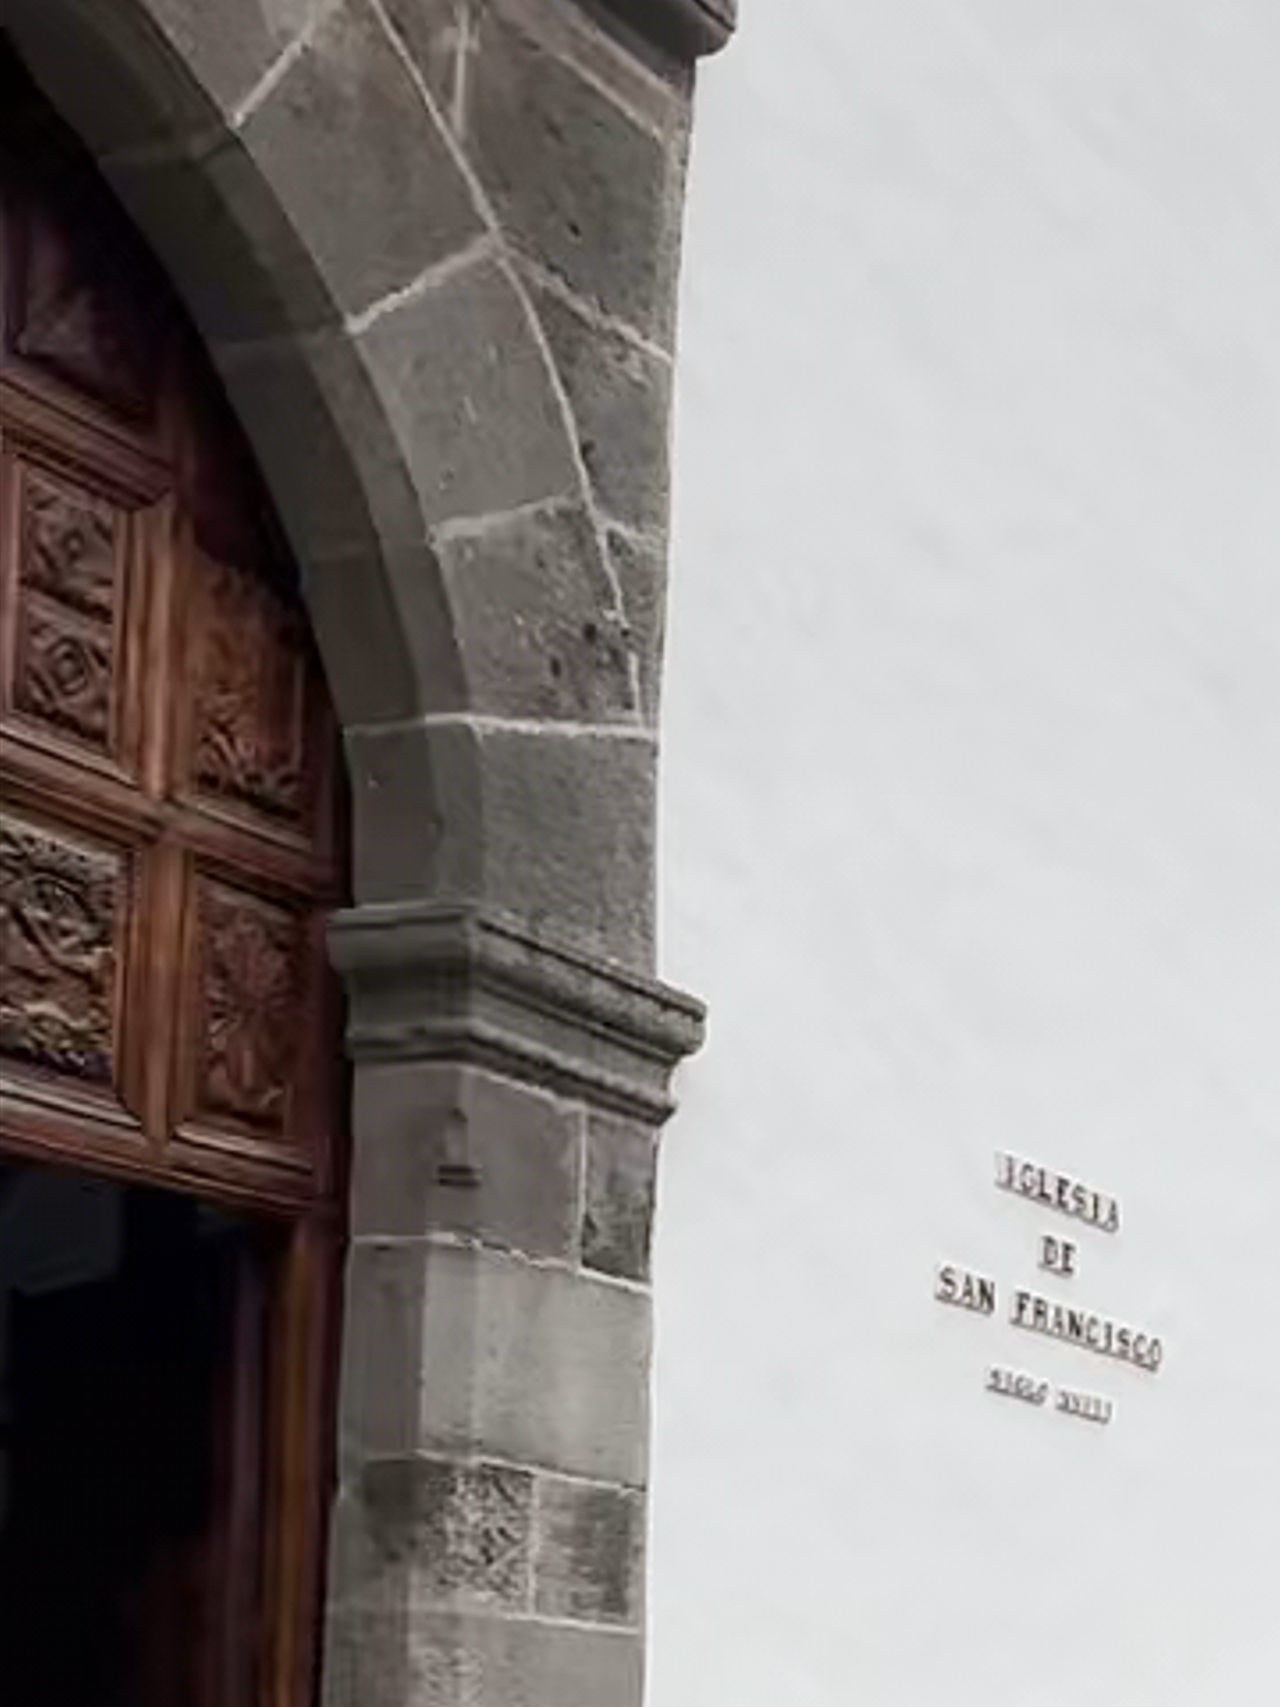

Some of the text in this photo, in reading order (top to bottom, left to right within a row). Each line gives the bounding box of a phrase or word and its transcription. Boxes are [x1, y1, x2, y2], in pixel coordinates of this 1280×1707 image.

[997, 1153, 1120, 1233] IGLESIA
[1039, 1235, 1076, 1277] DE
[935, 1266, 1162, 1372] SAN FRANCISCO
